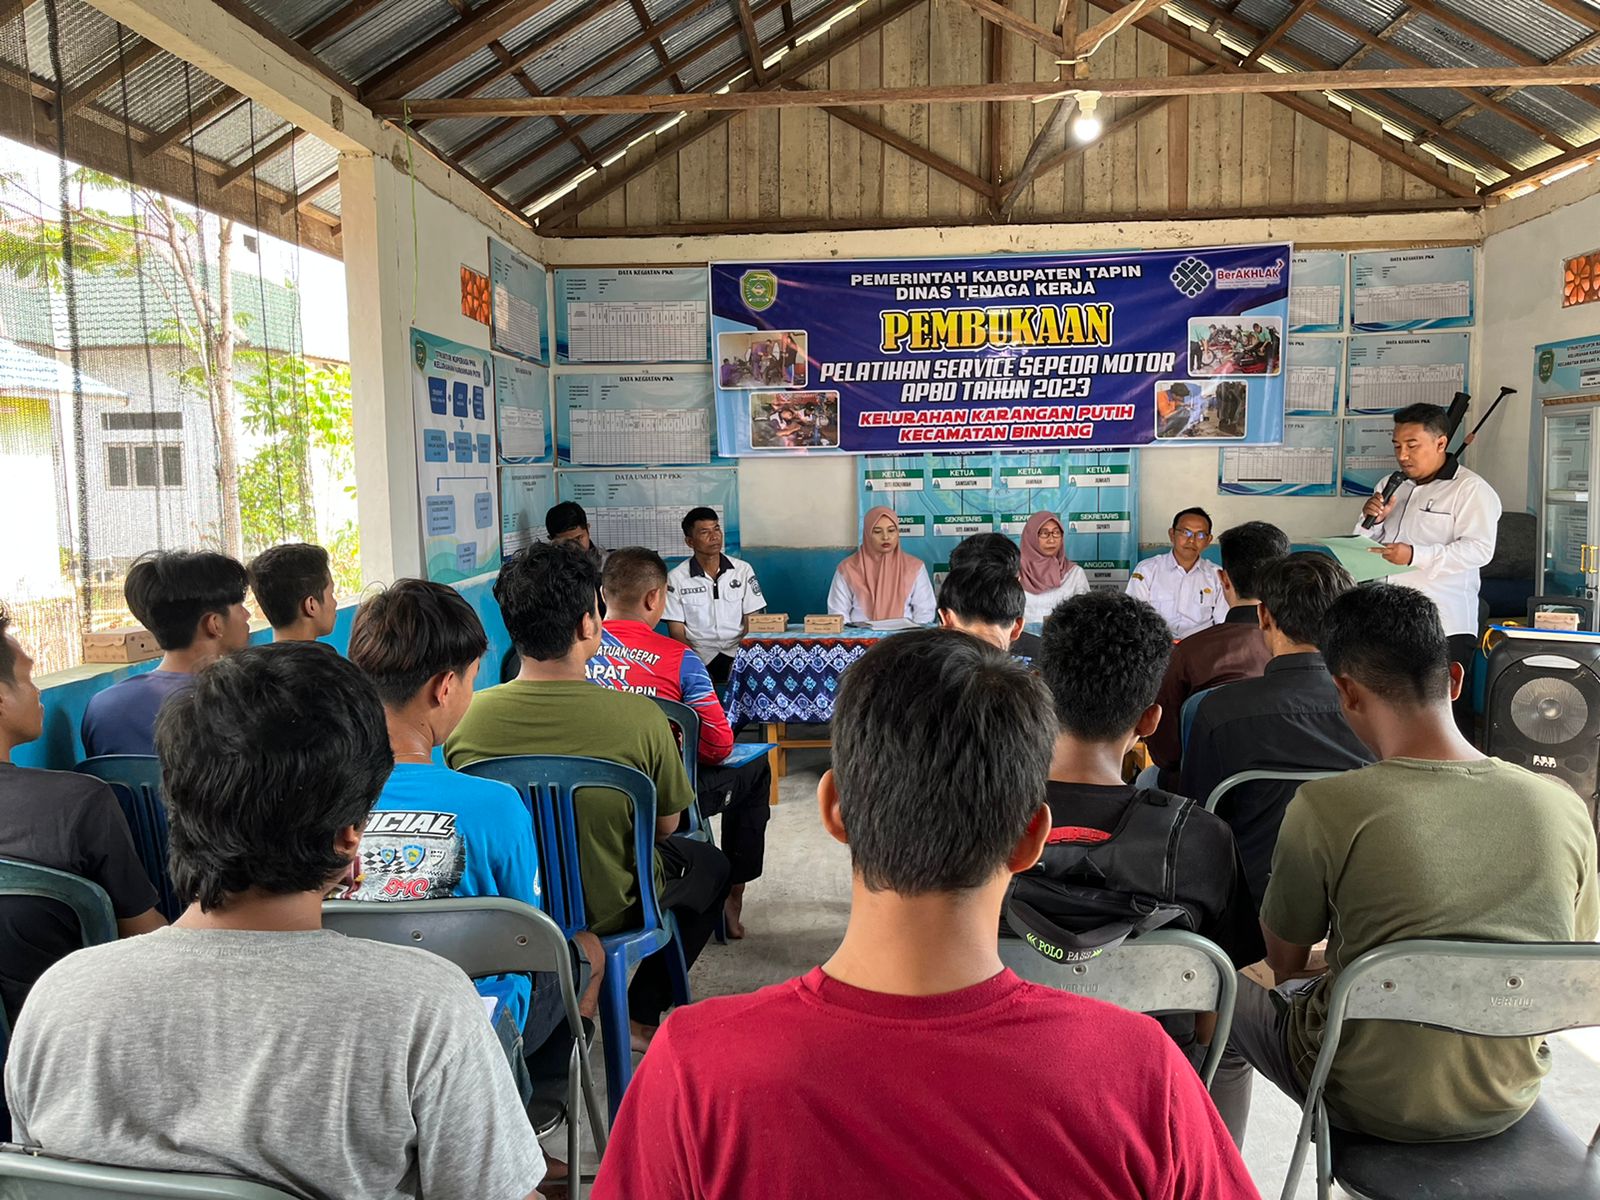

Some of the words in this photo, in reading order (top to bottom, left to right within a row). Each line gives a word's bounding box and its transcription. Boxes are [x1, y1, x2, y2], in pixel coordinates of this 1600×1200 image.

[851, 271, 967, 286] PEMERINTAH
[972, 268, 1081, 283] KABUPATEN
[1086, 265, 1141, 279] TAPIN
[1217, 267, 1279, 280] BerAKHLAK
[896, 286, 952, 300] DINAS
[956, 283, 1030, 299] TENAGA
[1035, 282, 1095, 296] KERJA
[881, 303, 1114, 353] PEMBUKAAN
[820, 361, 930, 382] PELATIHAN
[934, 357, 1017, 380] SERVICE
[1018, 354, 1099, 377] SEPEDA
[1101, 352, 1176, 374] MOTOR
[901, 381, 957, 403] APBD
[961, 379, 1029, 401] TAHUN
[1032, 377, 1091, 399] 2023
[859, 409, 970, 427] KELURAHAN
[971, 406, 1074, 425] KARANGAN
[1077, 404, 1136, 421] PUTIH
[898, 426, 1007, 443] KECAMATAN
[1010, 423, 1093, 440] BINUANG
[596, 645, 628, 658] ATUAN
[630, 648, 661, 665] CEPAT
[584, 664, 630, 680] APAT
[364, 812, 454, 834] ICIAL
[1038, 940, 1064, 960] POLO
